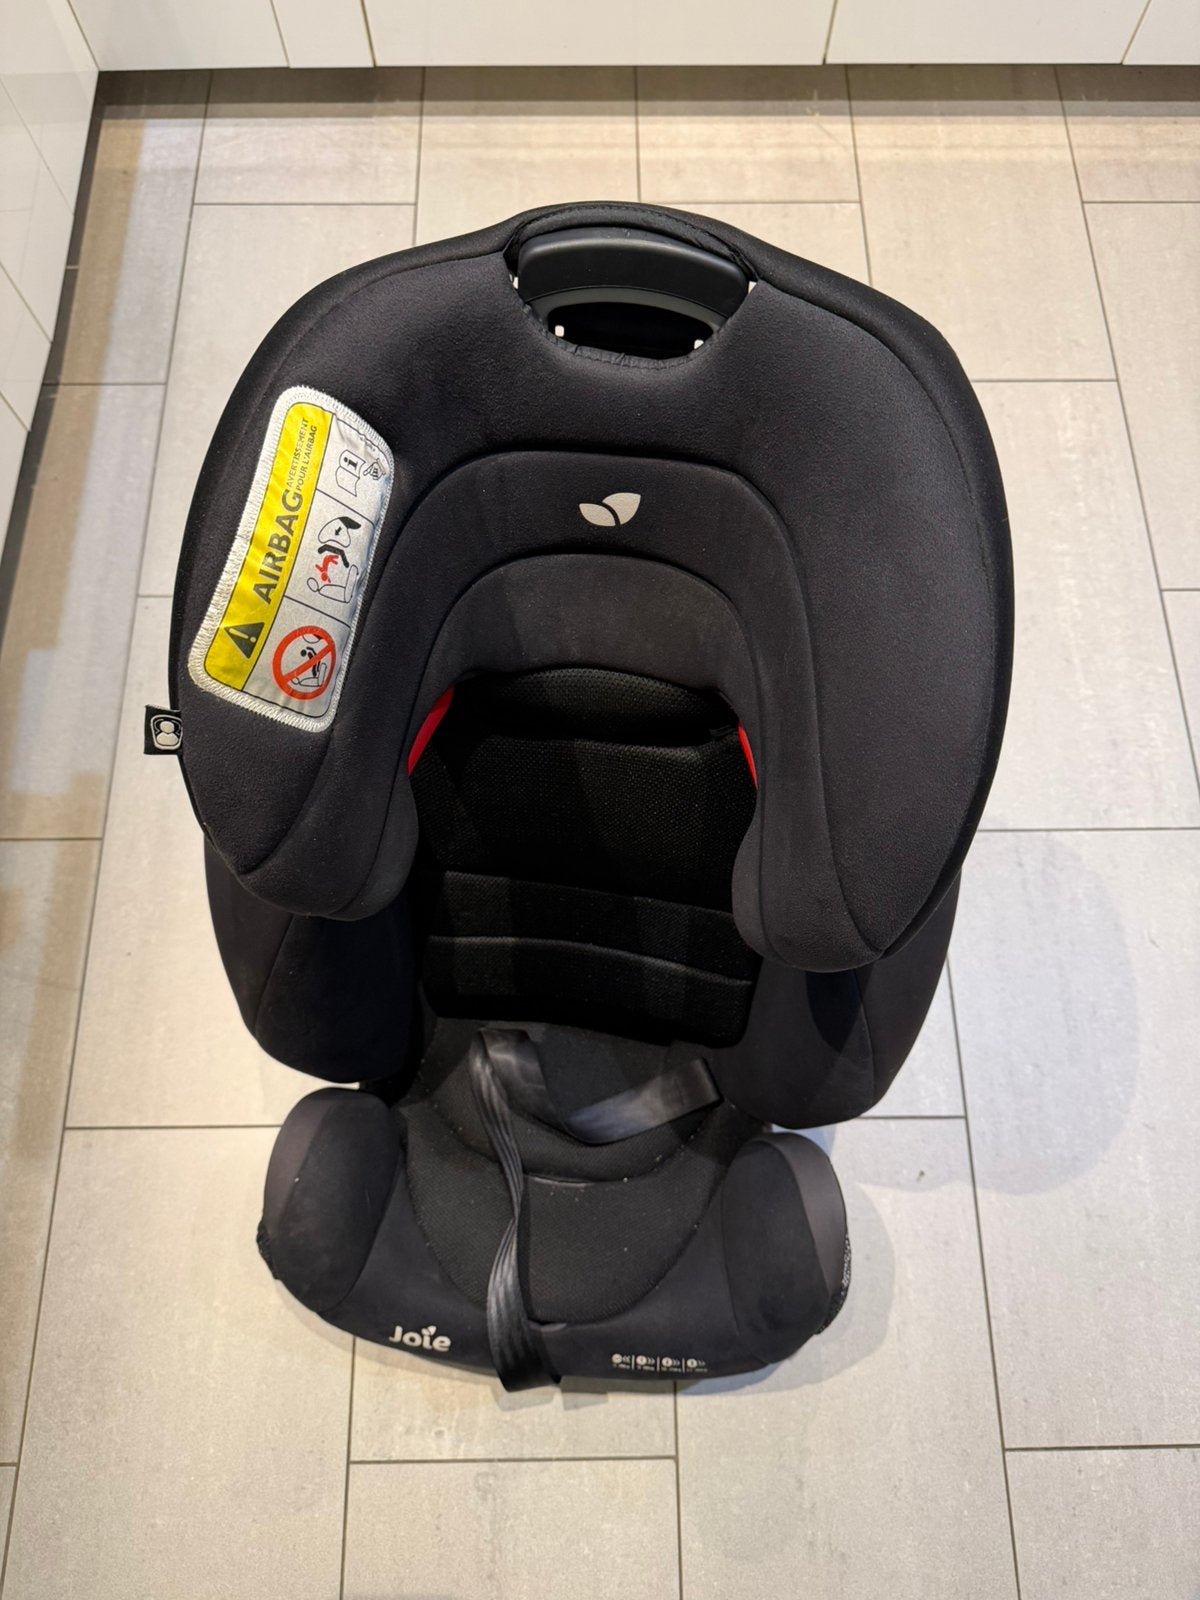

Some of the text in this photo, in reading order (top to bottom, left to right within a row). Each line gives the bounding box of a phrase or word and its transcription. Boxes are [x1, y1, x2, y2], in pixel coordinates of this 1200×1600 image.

[286, 417, 309, 488] AVERTISSEMENT
[295, 425, 318, 492] POUR L'AIRBAG
[253, 489, 303, 605] AIRBAG
[388, 1325, 451, 1352] Joie
